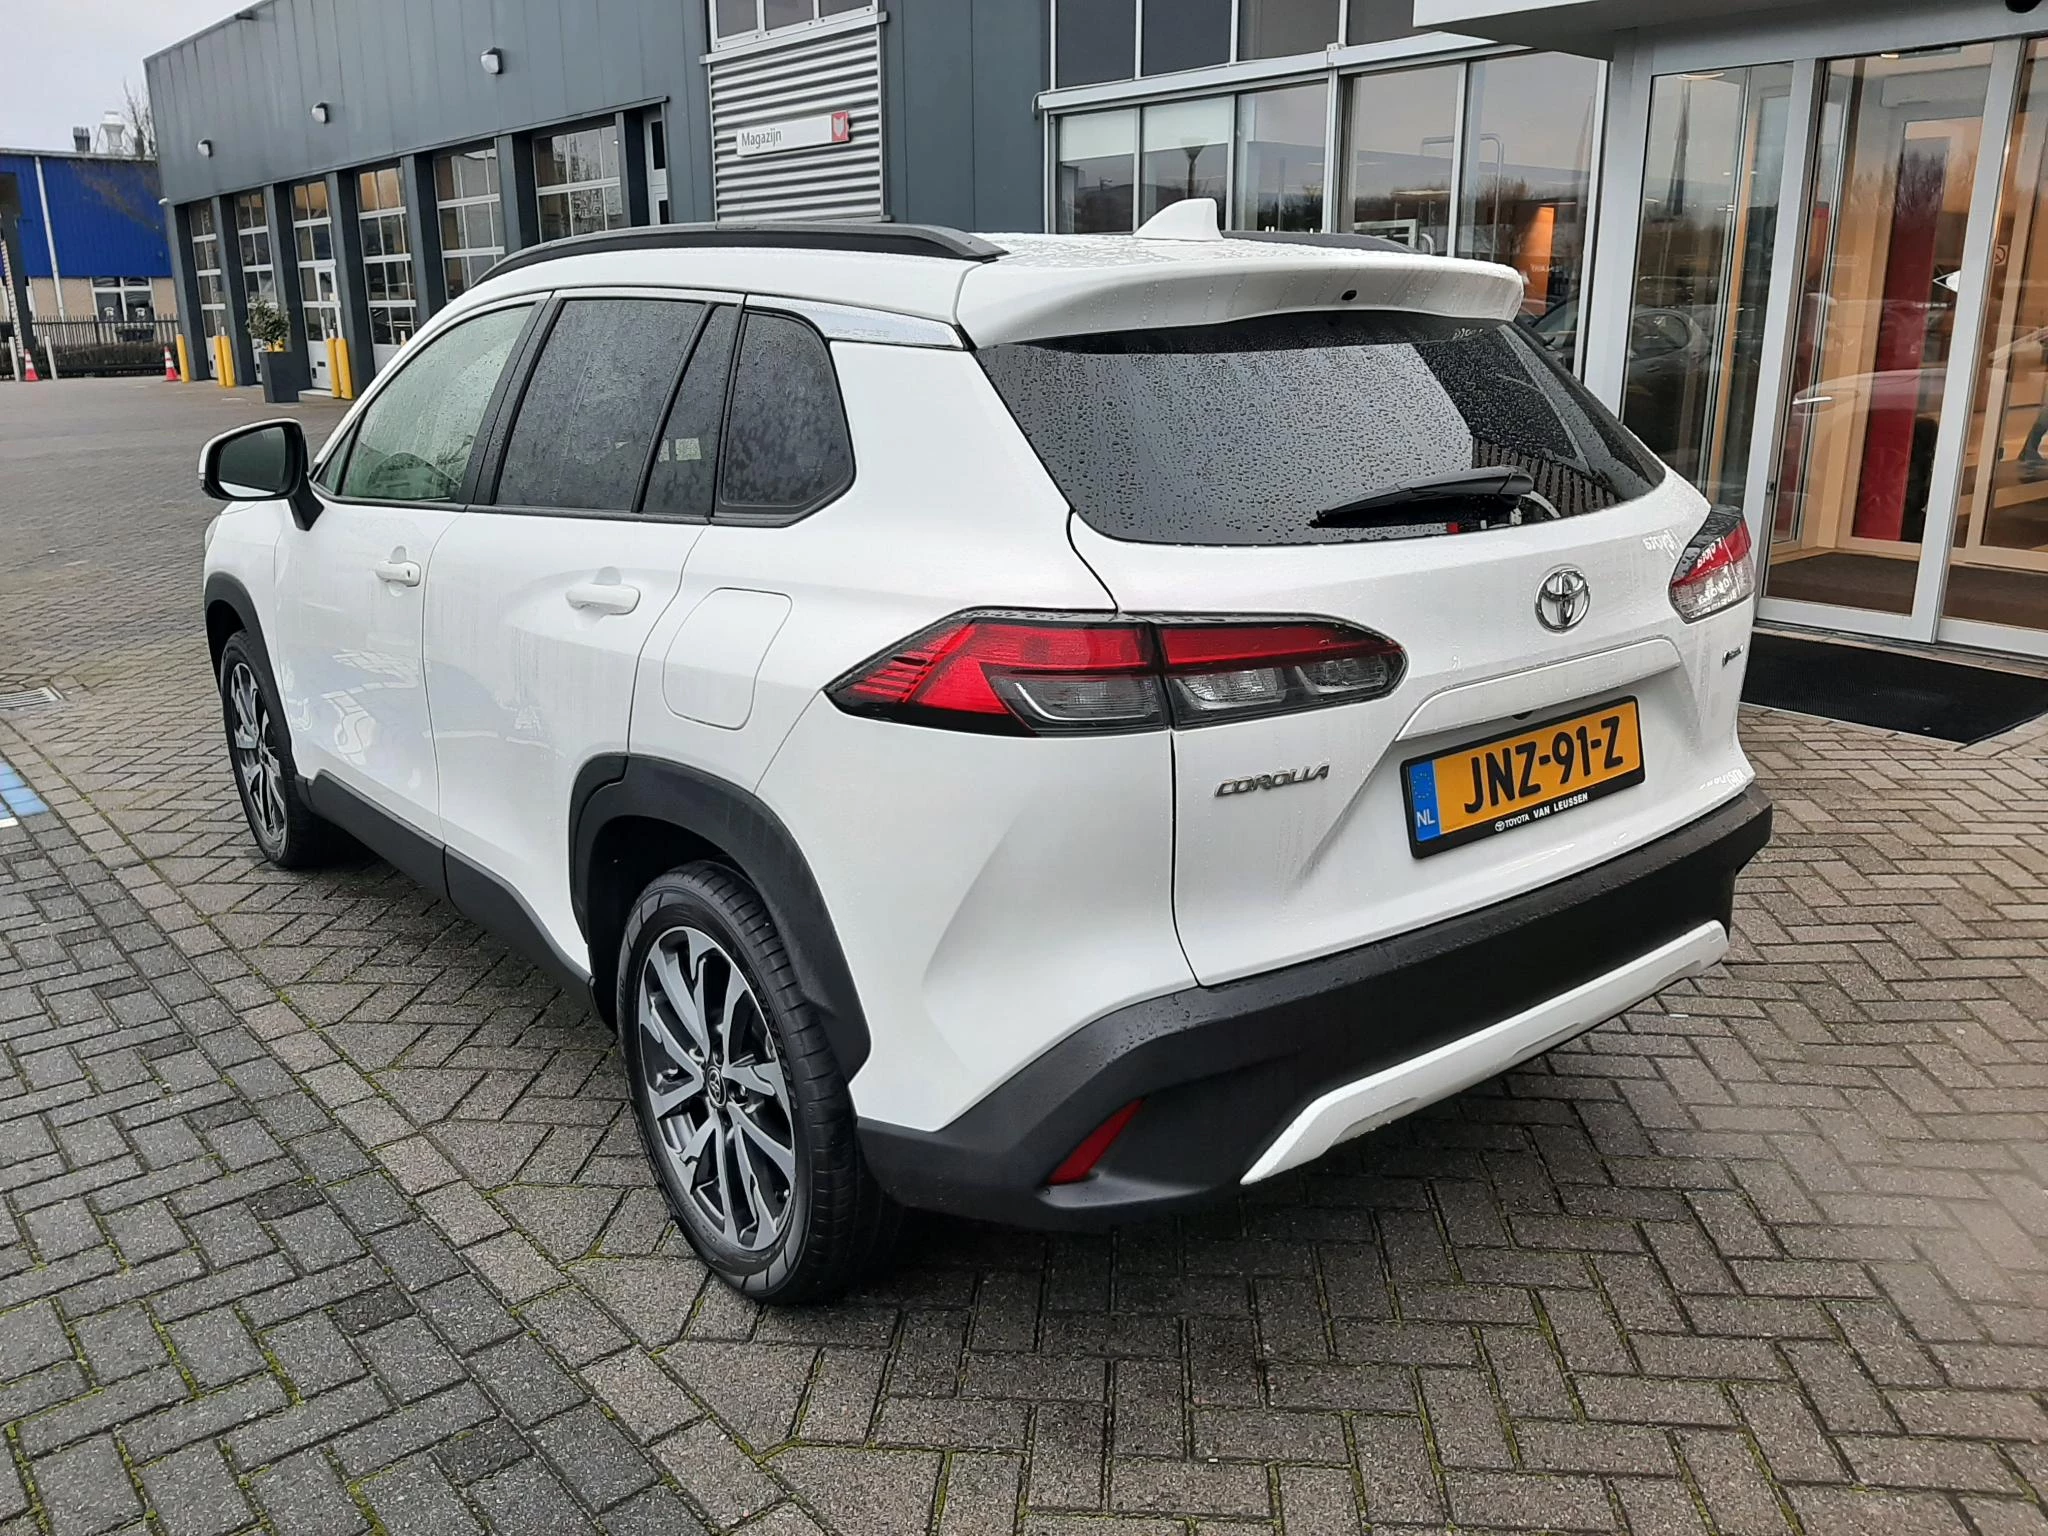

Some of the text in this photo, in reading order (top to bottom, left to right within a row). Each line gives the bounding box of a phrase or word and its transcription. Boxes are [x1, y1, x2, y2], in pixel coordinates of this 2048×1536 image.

[741, 128, 782, 149] Magazijn
[1213, 762, 1330, 797] COROLLA
[1464, 715, 1624, 814] JNZ-91-Z
[1416, 809, 1436, 828] NL
[1505, 792, 1588, 828] TOYOTA VAN LEUSSEN
